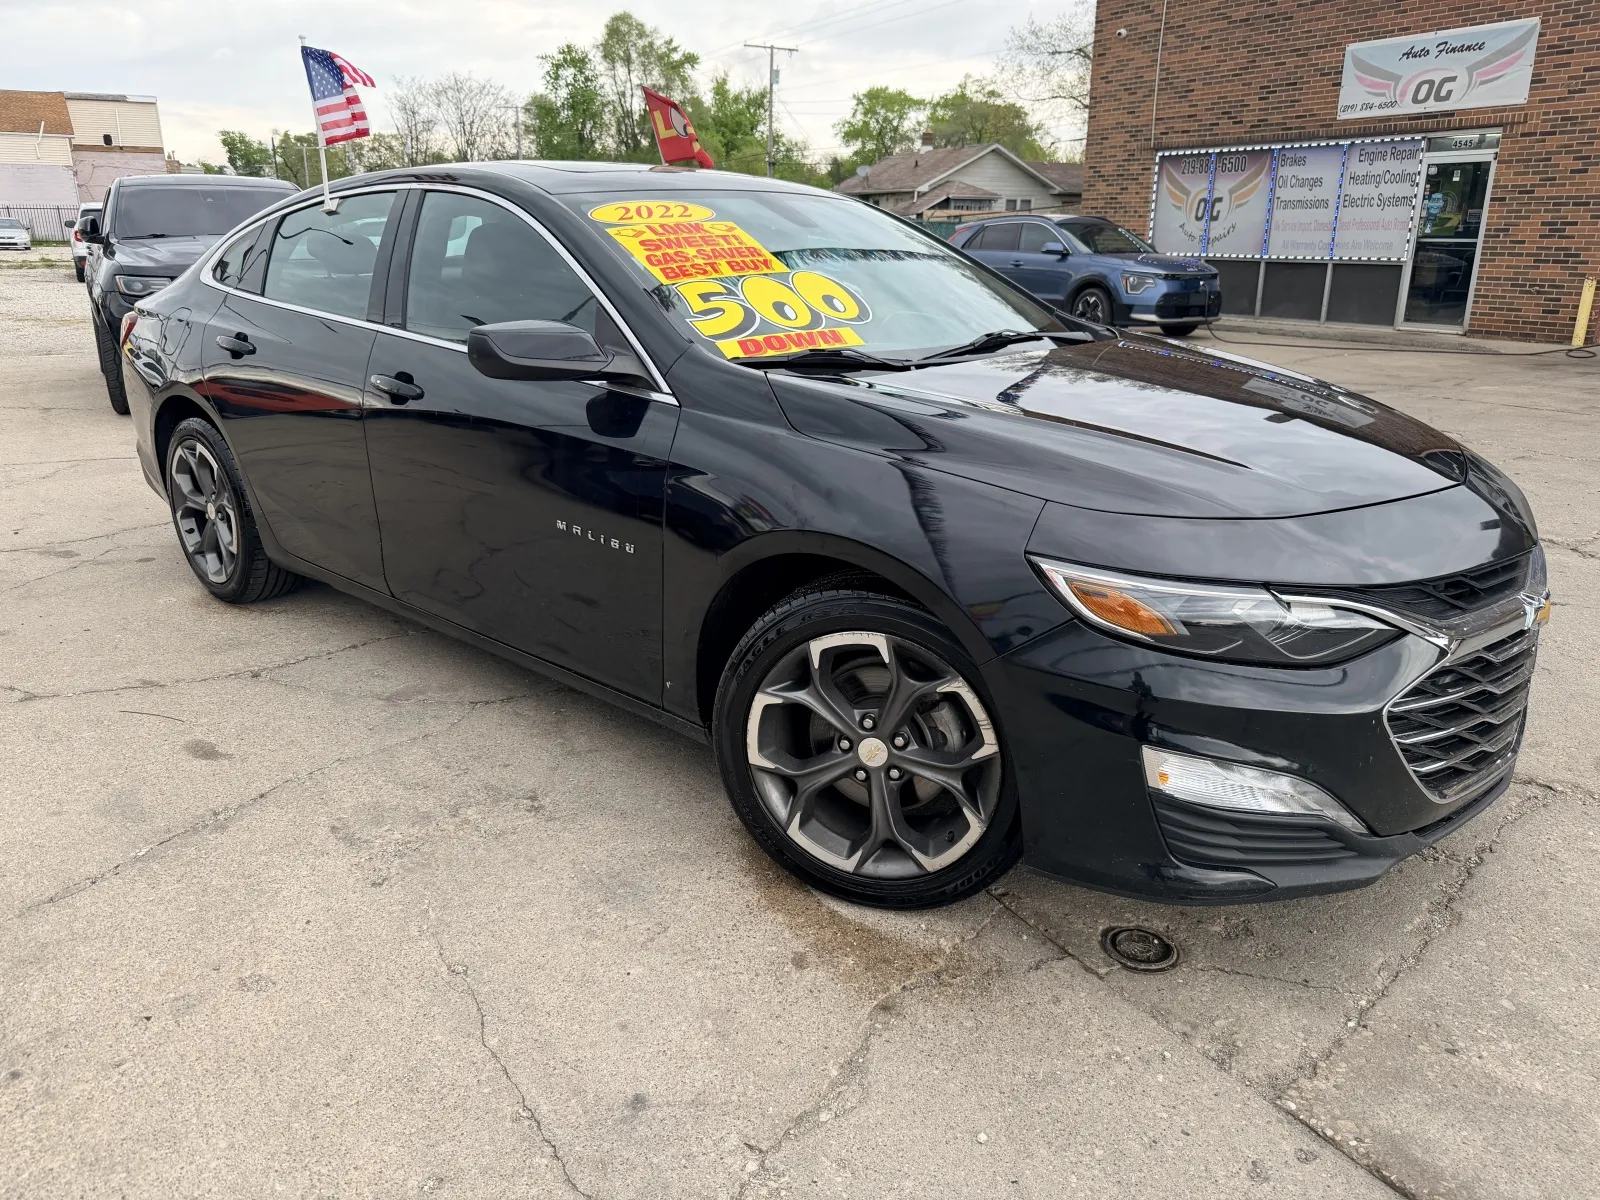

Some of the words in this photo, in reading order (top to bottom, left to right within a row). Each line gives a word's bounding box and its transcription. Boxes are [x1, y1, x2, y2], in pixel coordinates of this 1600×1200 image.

[1399, 45, 1430, 61] Auto
[1435, 41, 1486, 60] Finance
[1411, 75, 1458, 105] OG
[1339, 103, 1357, 113] (219)
[1360, 100, 1397, 111] 884-6500
[1453, 140, 1473, 148] 4545
[1280, 153, 1307, 167] Brakes
[1358, 147, 1388, 166] Engine
[1390, 144, 1419, 164] Repair
[1278, 175, 1288, 189] Oil
[1289, 174, 1323, 191] Changes
[1348, 169, 1417, 188] Heating/Cooling
[1275, 196, 1329, 210] Transmissions
[1342, 193, 1374, 209] Electric
[1376, 193, 1414, 211] Systems
[614, 204, 693, 221] 2022
[645, 222, 714, 237] LOOK
[1179, 222, 1197, 241] Auto
[1281, 220, 1297, 232] Service
[638, 234, 746, 252] SWEET!
[1290, 240, 1317, 252] Warranty
[1363, 239, 1393, 250] Welcome
[645, 246, 766, 268] GAS-SAVER
[659, 261, 724, 281] BEST
[725, 258, 775, 273] BUY
[673, 270, 873, 342] 500
[737, 329, 848, 357] DOWN
[556, 519, 635, 554] MALIBU
